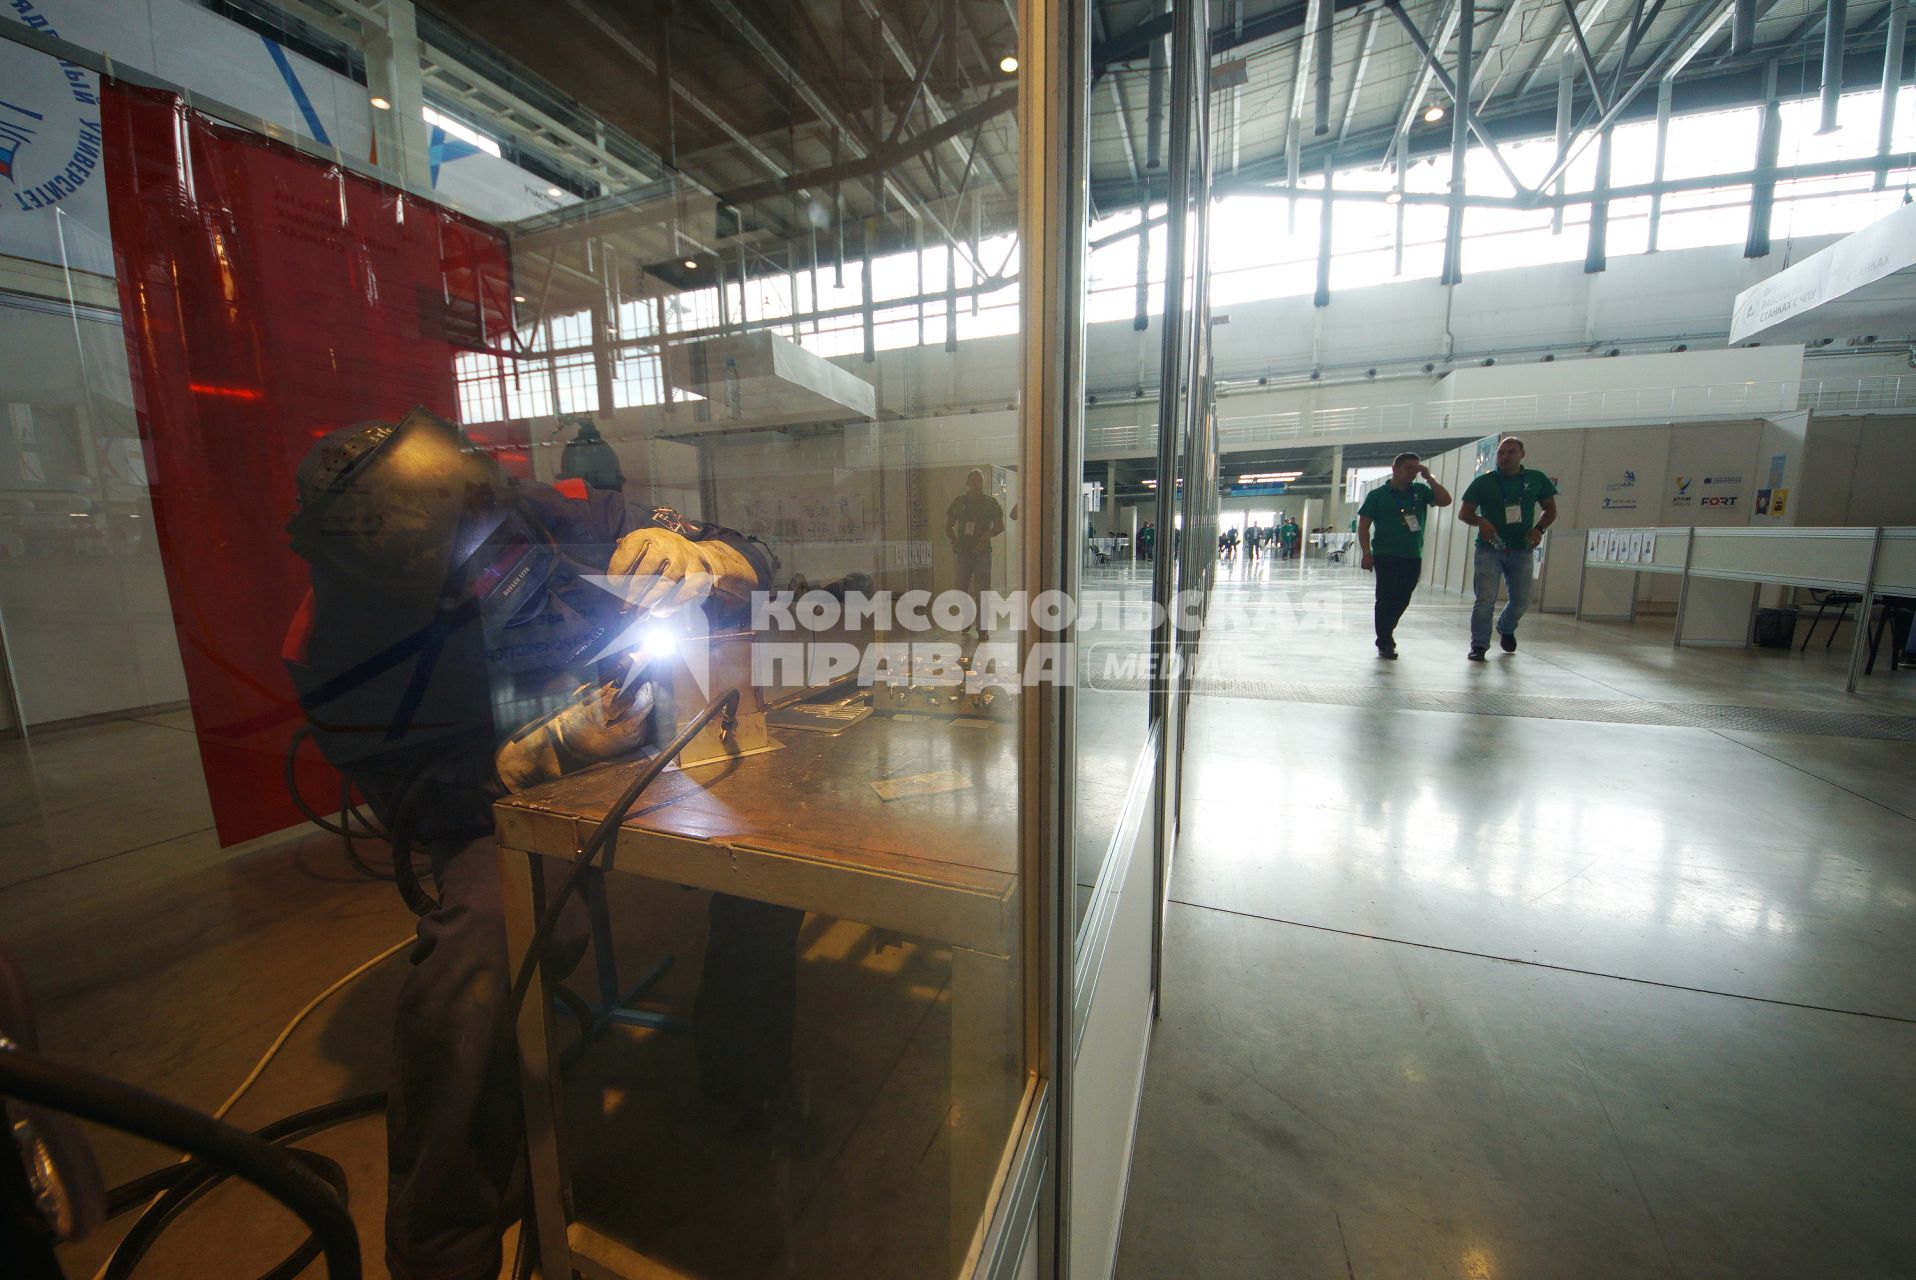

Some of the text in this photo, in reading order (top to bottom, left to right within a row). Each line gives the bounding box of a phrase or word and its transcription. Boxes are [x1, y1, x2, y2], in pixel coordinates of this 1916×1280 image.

[13, 117, 101, 211] УНИВЕРСИТЕТ
[1760, 300, 1791, 322] СТАНКАХ
[1701, 496, 1738, 506] FORT
